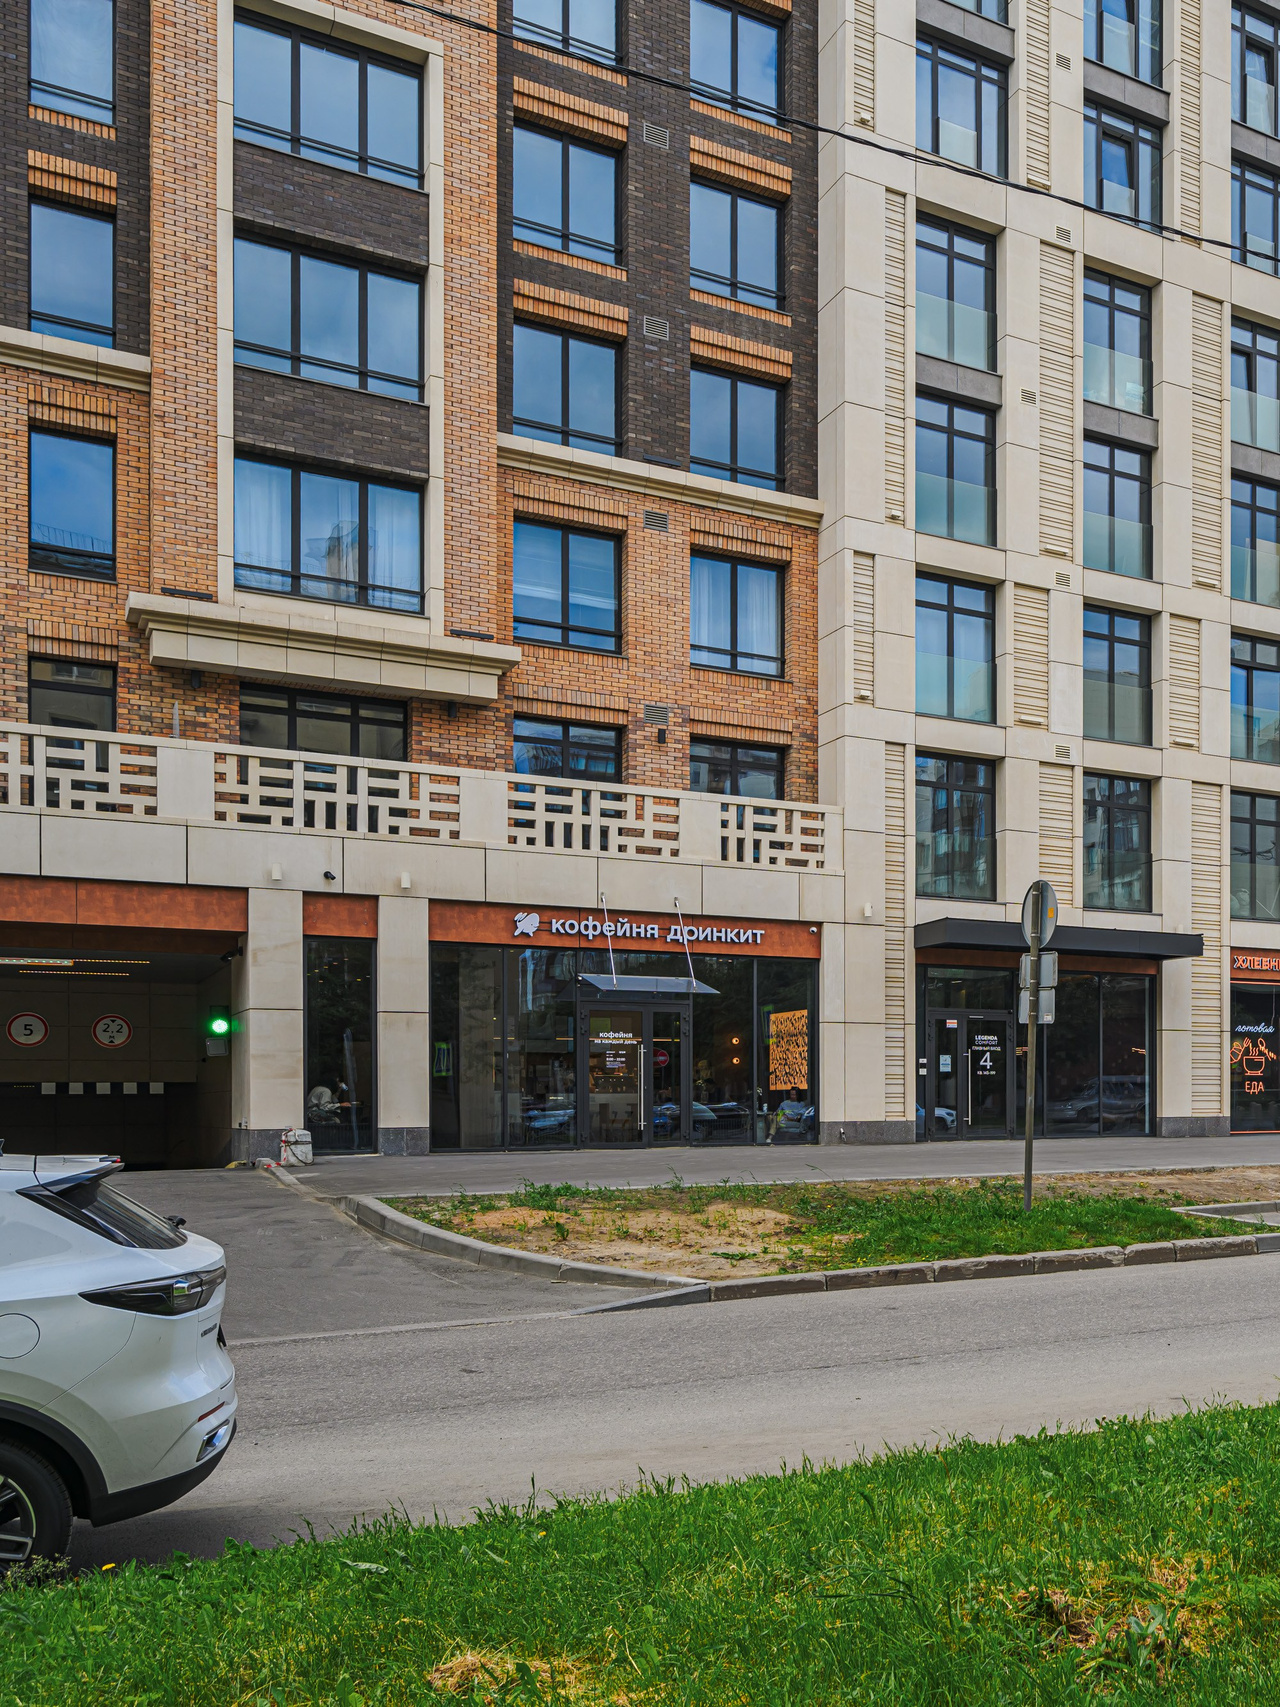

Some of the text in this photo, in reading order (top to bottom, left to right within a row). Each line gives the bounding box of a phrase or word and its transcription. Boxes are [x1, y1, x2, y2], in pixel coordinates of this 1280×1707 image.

[551, 916, 765, 944] кофейня дринкит
[23, 1023, 33, 1037] 5
[102, 1023, 124, 1034] 2,2
[599, 1031, 633, 1039] кофейня
[1234, 1022, 1275, 1034] готовая
[980, 1051, 993, 1069] 4
[1245, 1081, 1265, 1095] ЕДА
